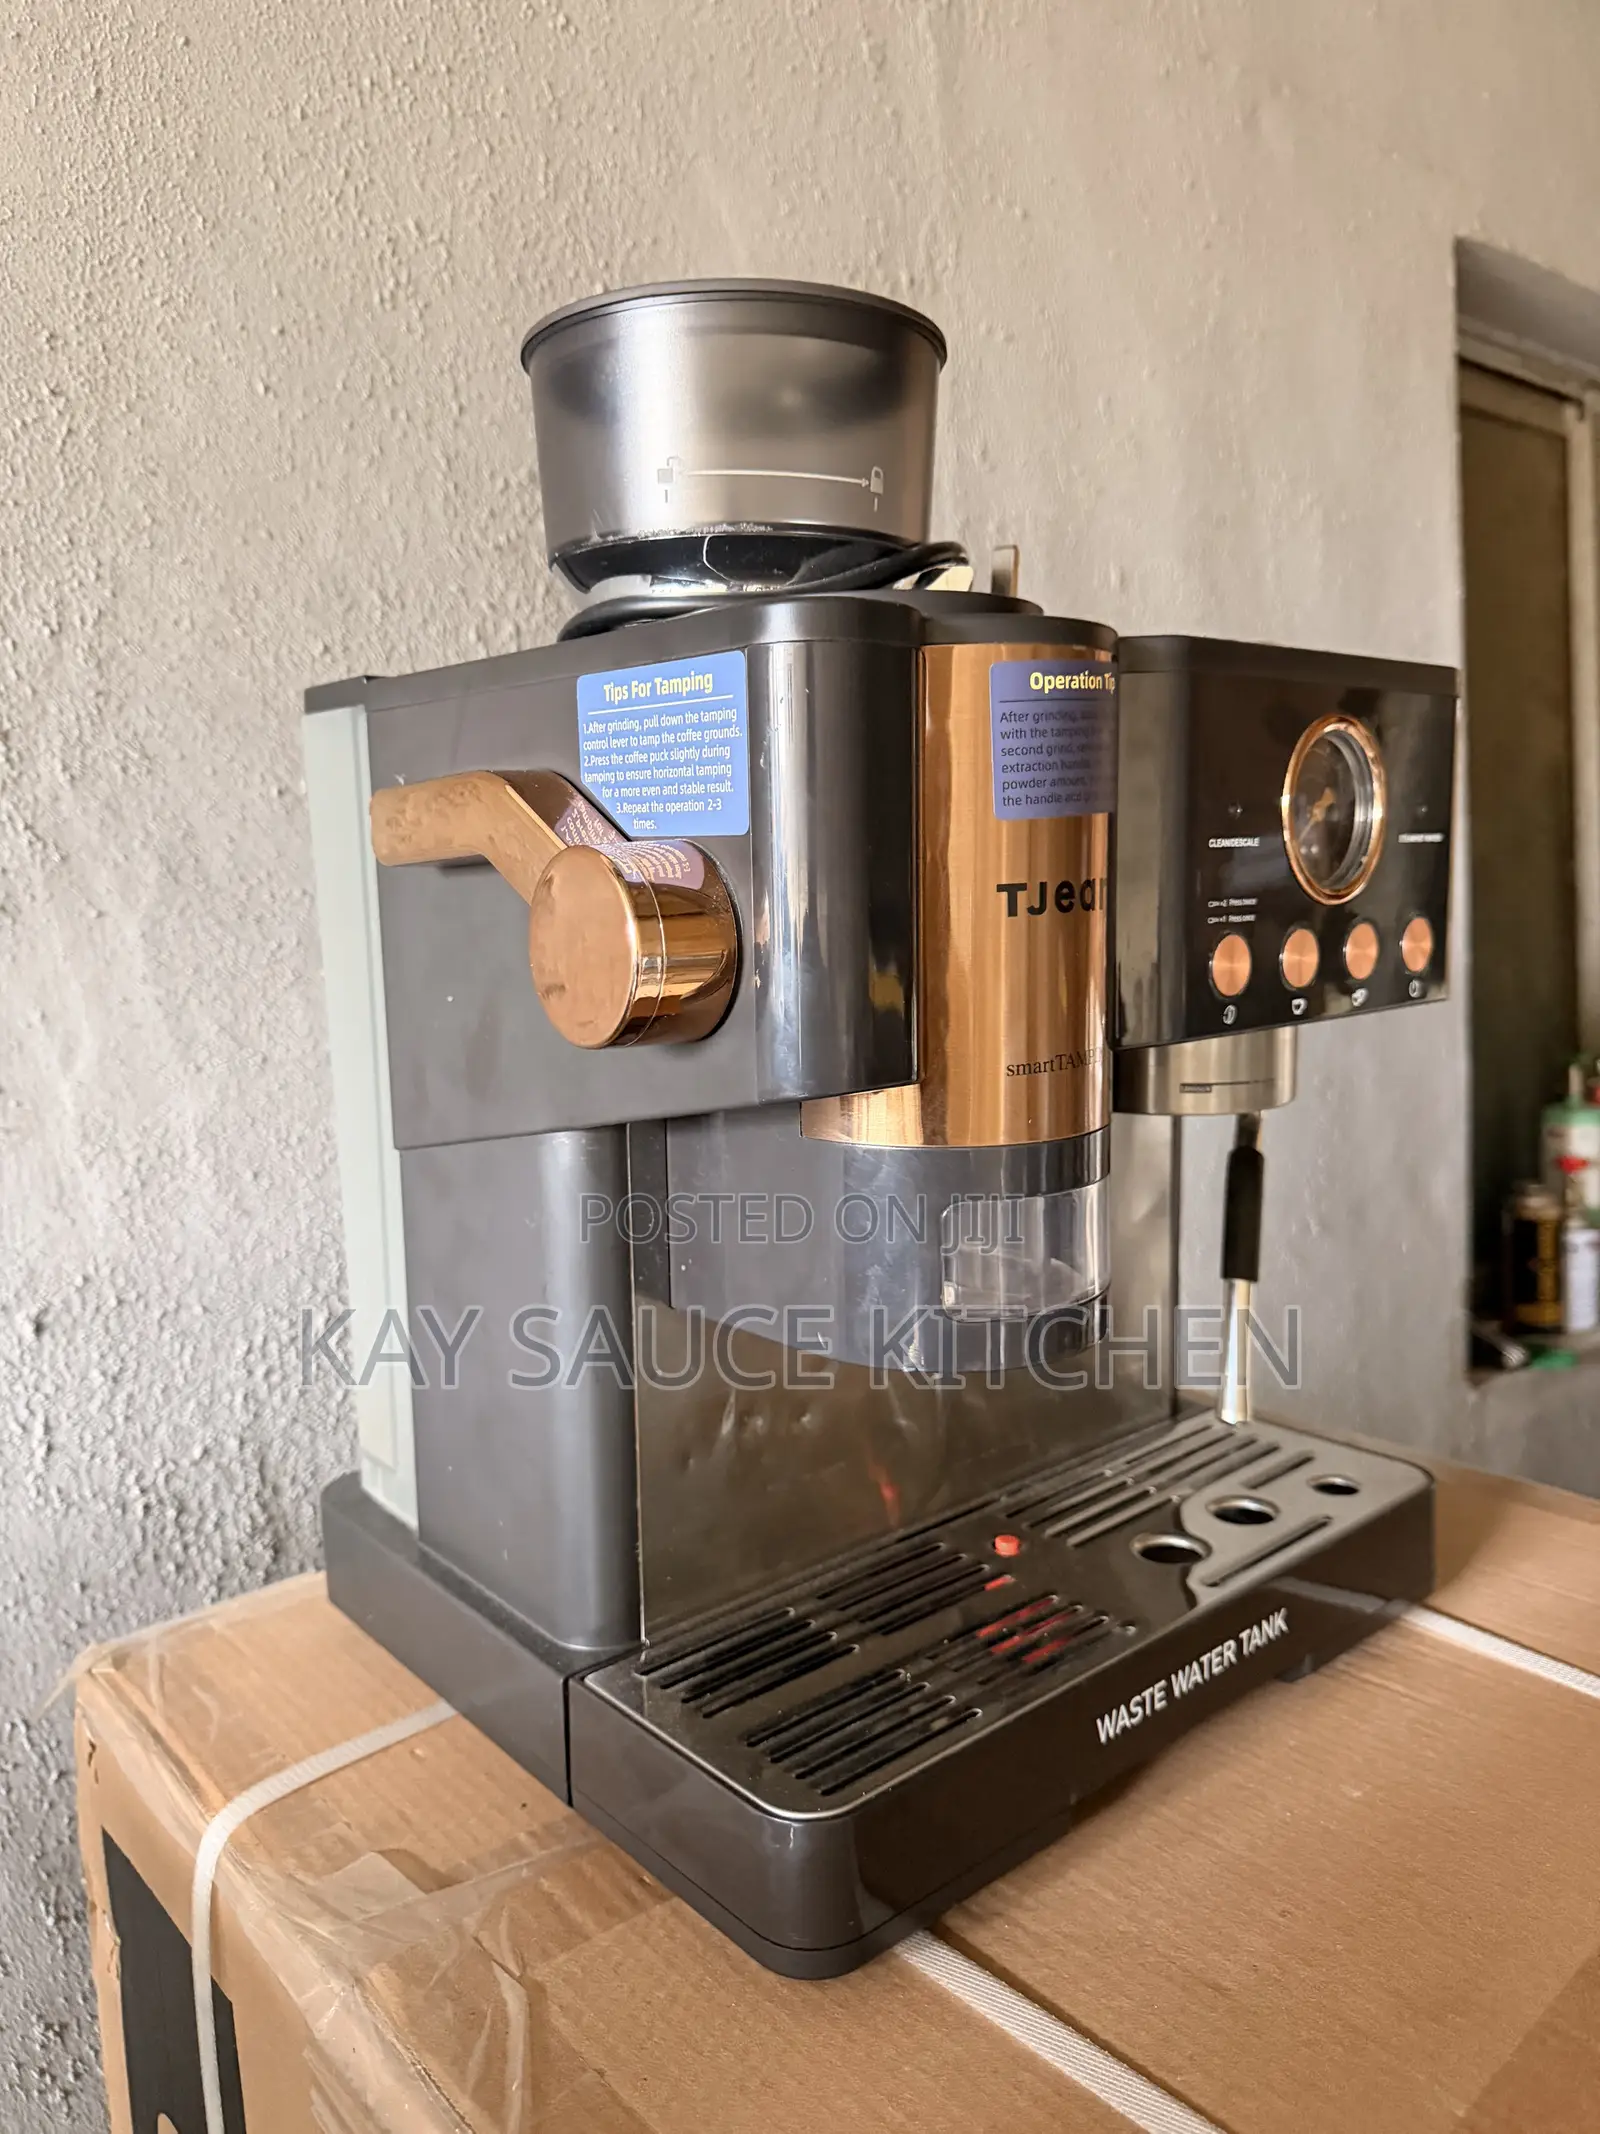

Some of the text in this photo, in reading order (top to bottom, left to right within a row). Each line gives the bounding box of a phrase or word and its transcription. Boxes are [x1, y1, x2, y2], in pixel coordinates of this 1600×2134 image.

[604, 671, 713, 705] Tips For Tamping
[1030, 670, 1102, 694] Operation
[583, 707, 736, 734] 1.After grinding, pull down the tamping
[1000, 710, 1029, 724] After
[583, 724, 743, 751] control lever to tamp the coffee grounds.
[1000, 728, 1027, 740] with
[1030, 727, 1048, 738] the
[584, 744, 731, 767] 2.Press the coffee puck slightly during
[1001, 743, 1043, 756] second
[584, 762, 732, 784] tamping to ensure horizontal tamping
[1001, 759, 1058, 774] extraction
[602, 779, 734, 798] for a more even and stable result.
[1002, 778, 1046, 793] powder
[616, 798, 722, 816] 3.Repeat the operation 2-3
[1002, 795, 1022, 807] the
[1025, 791, 1063, 805] handle
[633, 818, 657, 829] times.
[1096, 1607, 1290, 1745] WASTE WATER TANK
